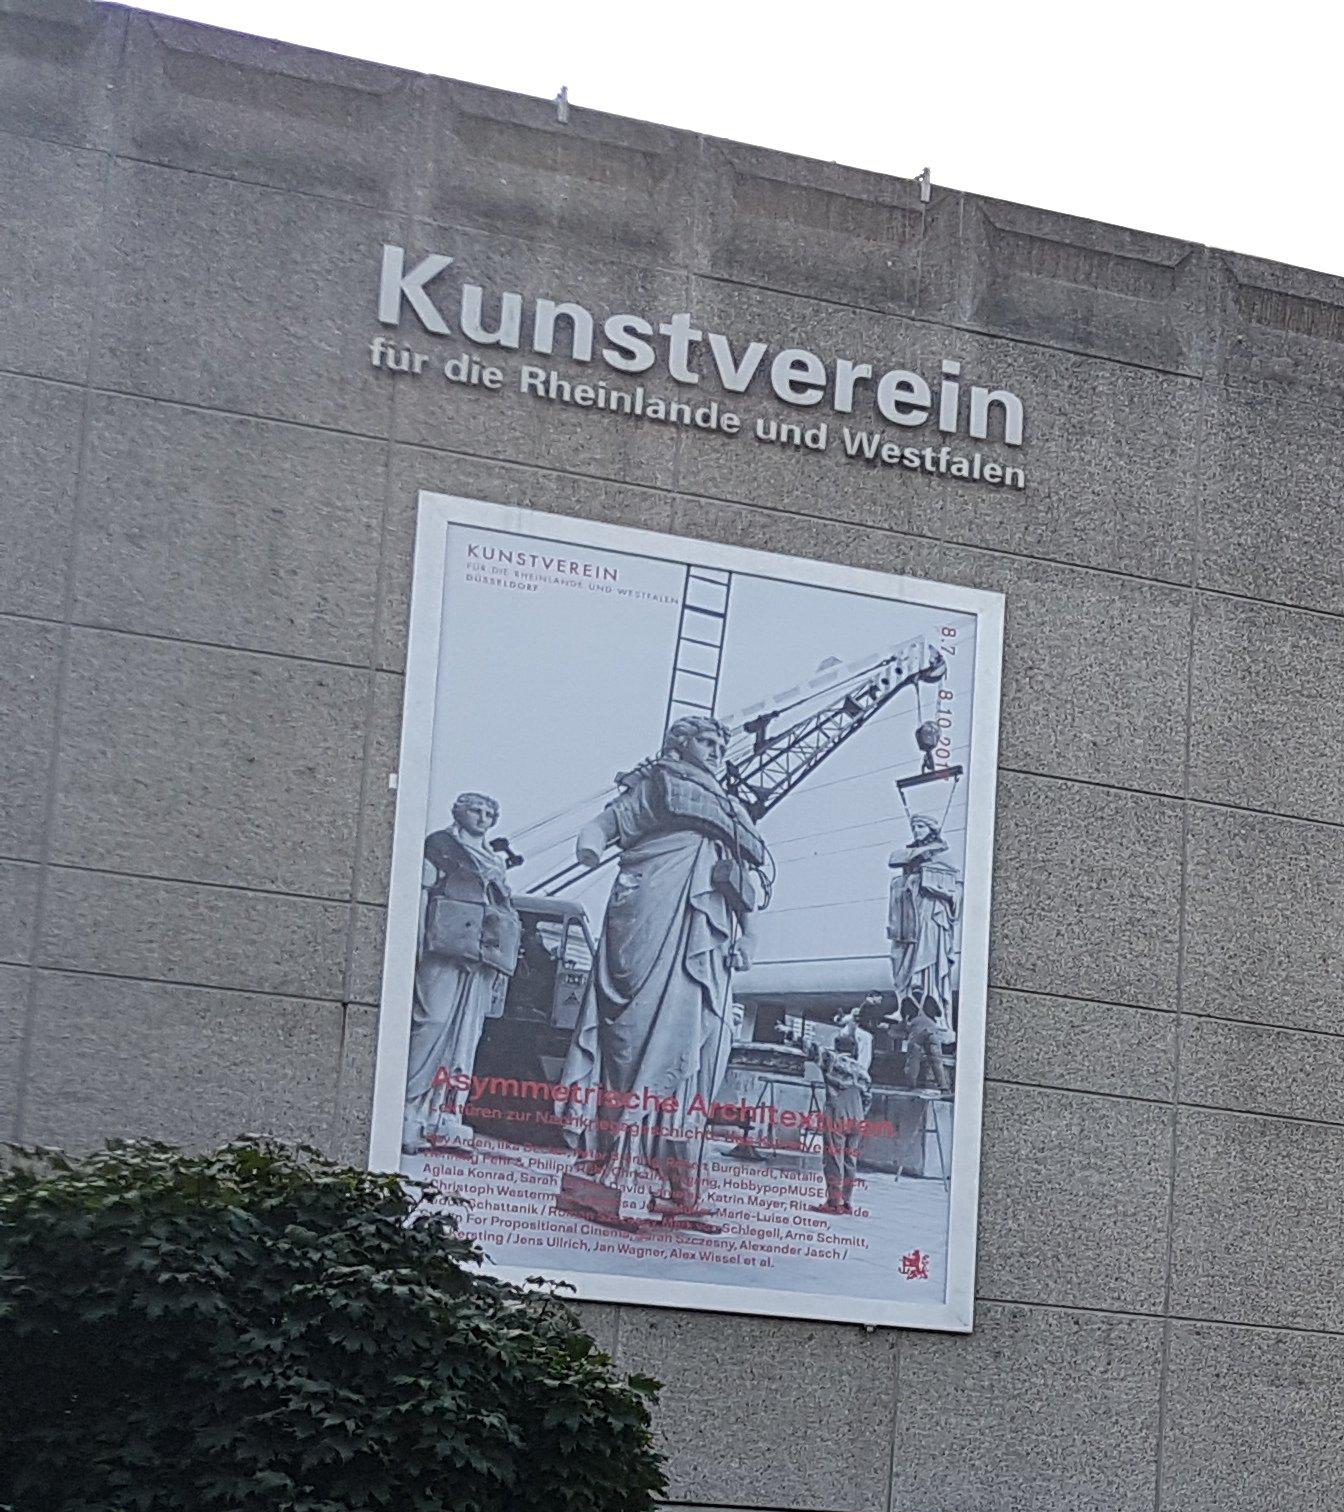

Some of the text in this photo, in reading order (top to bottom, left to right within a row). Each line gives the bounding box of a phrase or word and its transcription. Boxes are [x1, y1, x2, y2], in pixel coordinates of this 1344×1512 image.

[377, 243, 1024, 447] Kunstverein
[369, 336, 1026, 489] für die Rheinlande und Westfalen
[467, 543, 618, 582] KUNSTVEREIN
[431, 1064, 895, 1138] Asymmetrische Architexturen
[507, 1110, 531, 1121] zur
[468, 1167, 518, 1184] Konrad,
[520, 1173, 558, 1187] Sarah
[711, 1161, 778, 1180] Burghardt,
[430, 1178, 495, 1197] Christoph
[793, 1216, 832, 1231] Otten,
[466, 1213, 487, 1226] For
[491, 1215, 578, 1235] Propositional
[739, 1240, 802, 1256] Alexander
[804, 1247, 841, 1260] Jasch
[513, 1234, 544, 1247] Jens
[593, 1240, 615, 1254] Jan
[669, 1248, 697, 1261] Alex
[785, 1230, 814, 1242] Arne
